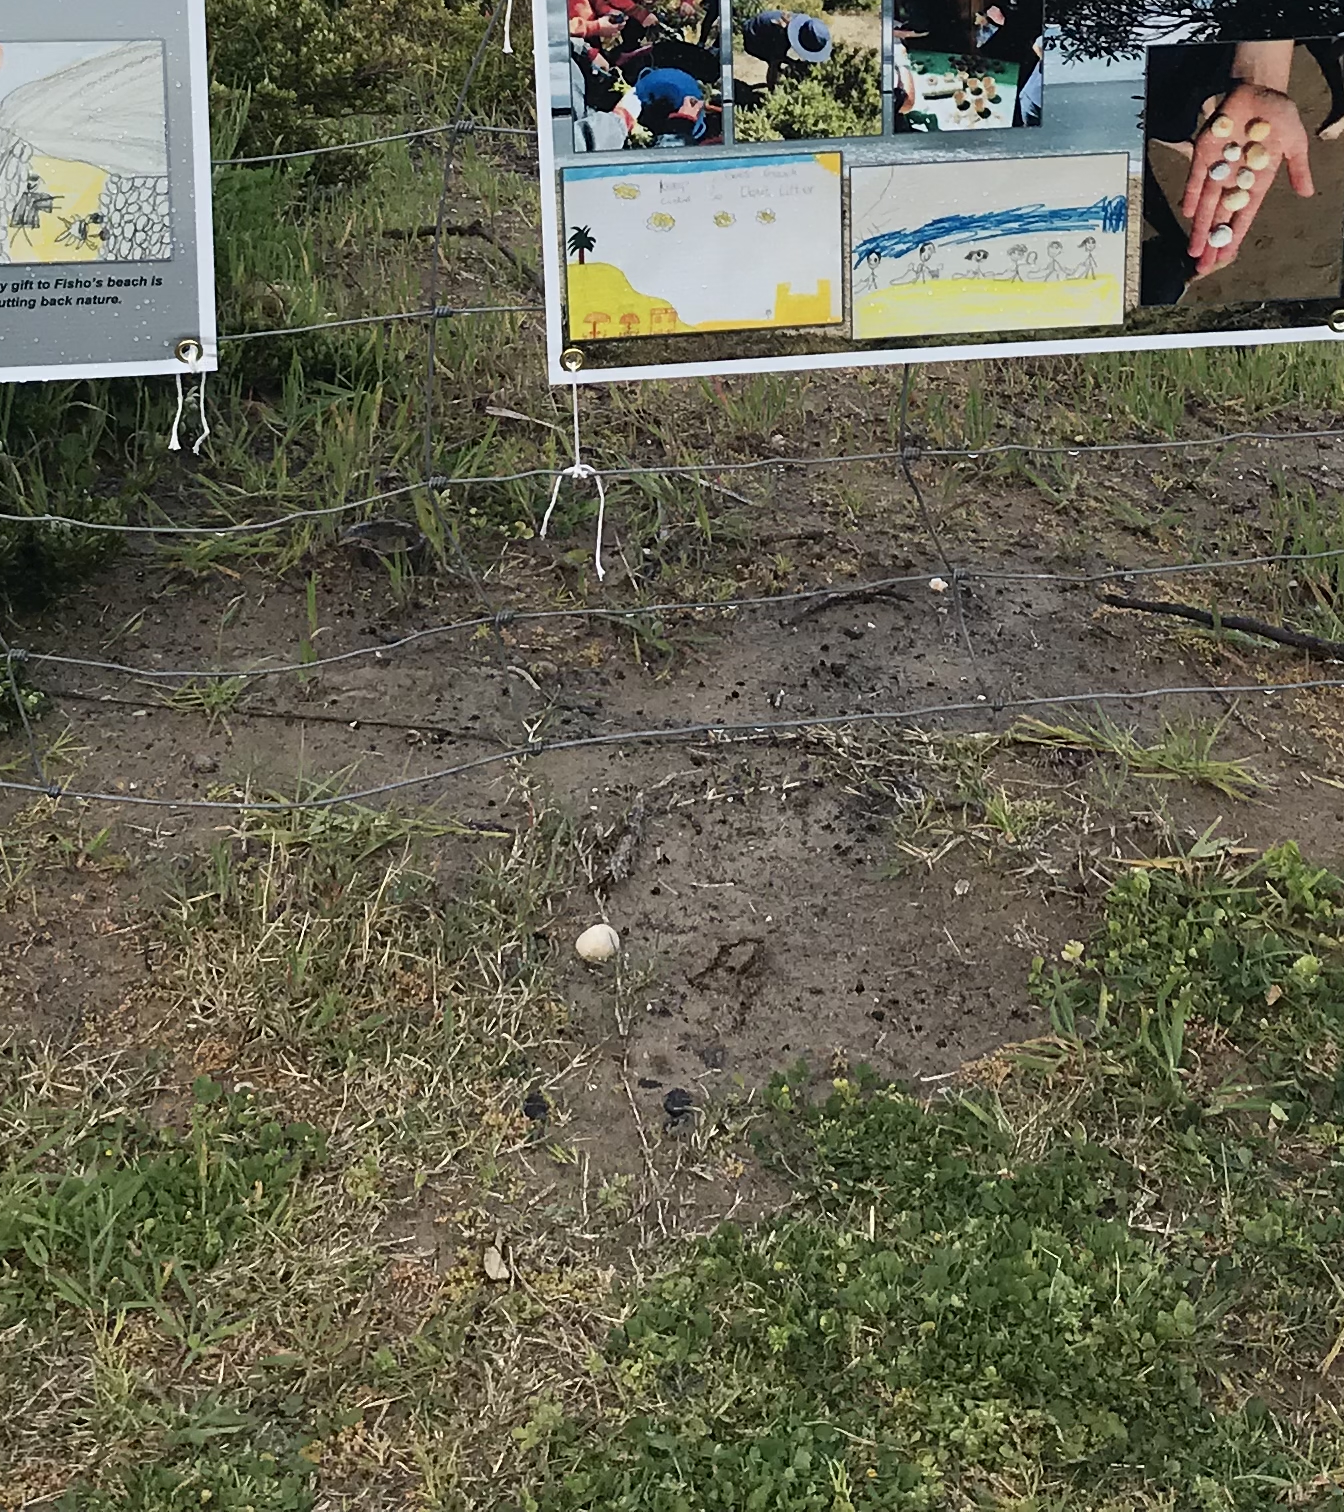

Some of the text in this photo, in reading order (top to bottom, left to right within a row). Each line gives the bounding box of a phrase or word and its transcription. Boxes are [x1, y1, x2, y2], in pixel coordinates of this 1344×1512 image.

[11, 279, 33, 292] gift
[37, 280, 50, 290] to
[106, 276, 147, 287] beach
[150, 275, 162, 286] is
[40, 295, 72, 306] back
[75, 295, 121, 305] nature.
